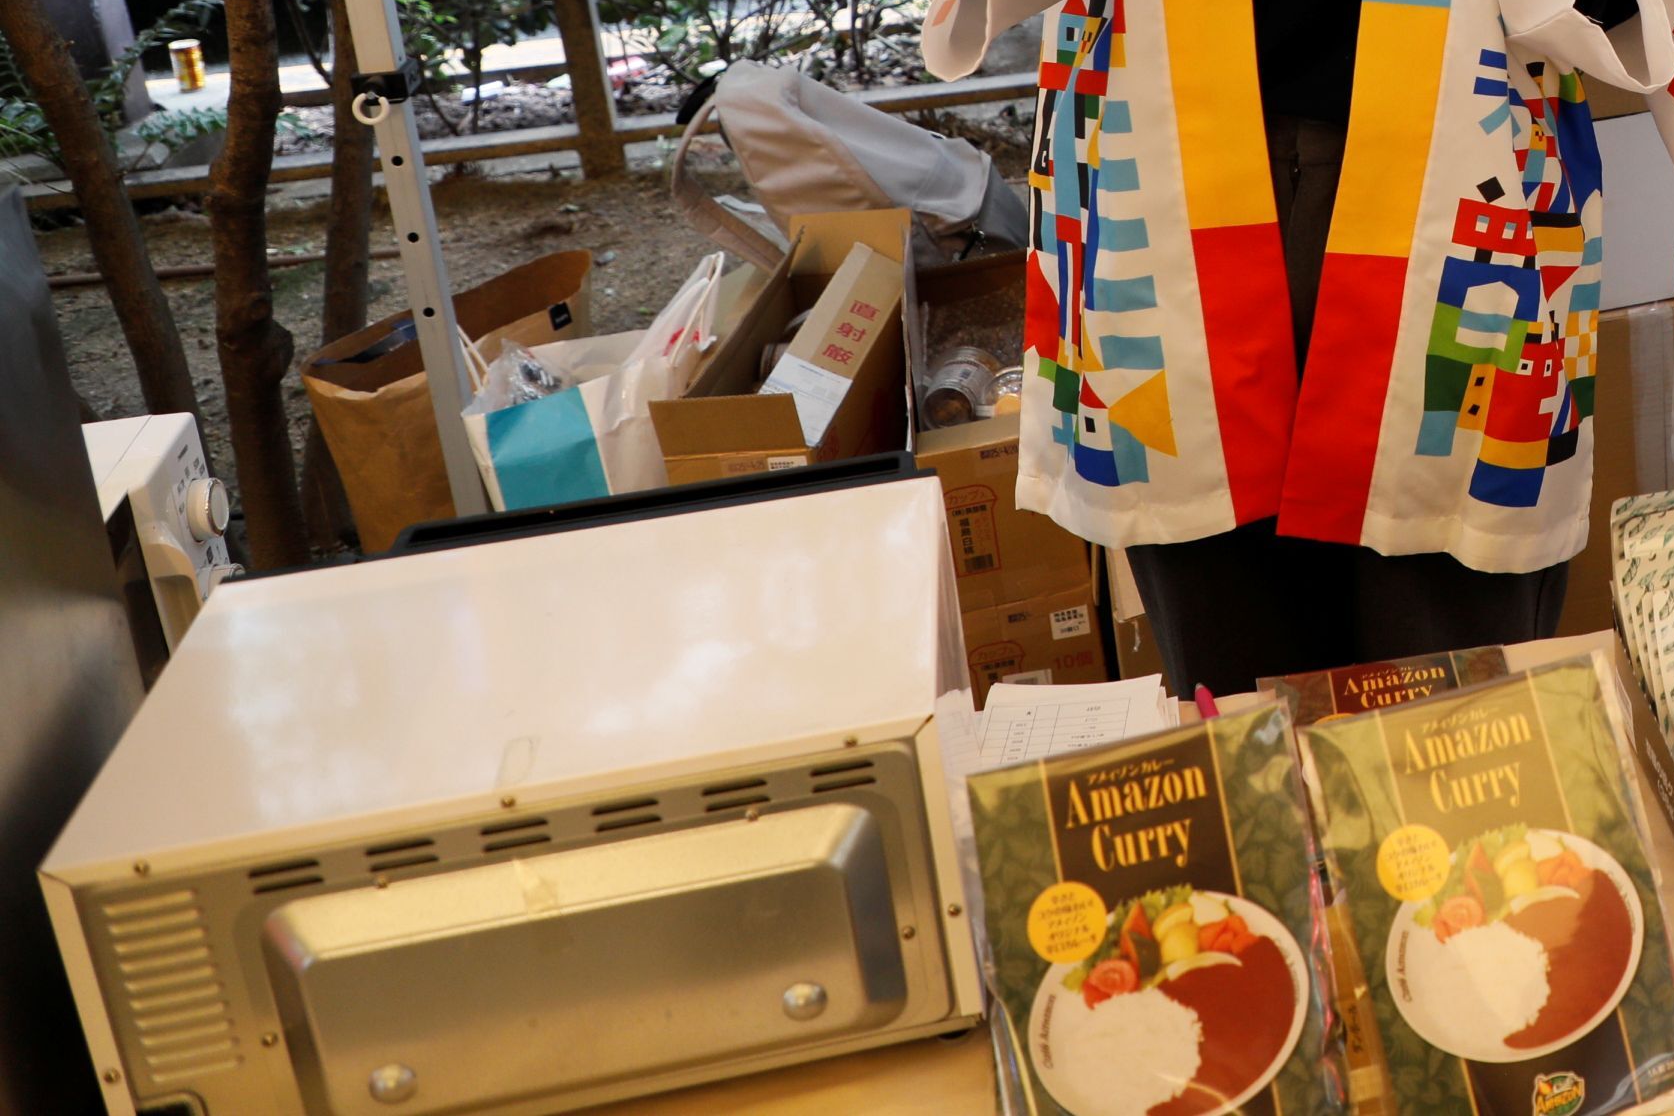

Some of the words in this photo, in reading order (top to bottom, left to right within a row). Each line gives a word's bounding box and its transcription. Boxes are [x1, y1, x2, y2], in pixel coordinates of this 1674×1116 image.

[1344, 665, 1446, 696] Amazon
[1360, 684, 1433, 709] Curry
[1404, 712, 1532, 775] Amazon
[1066, 765, 1208, 830] Amazon
[1429, 761, 1521, 814] Curry
[1091, 817, 1193, 873] Curry
